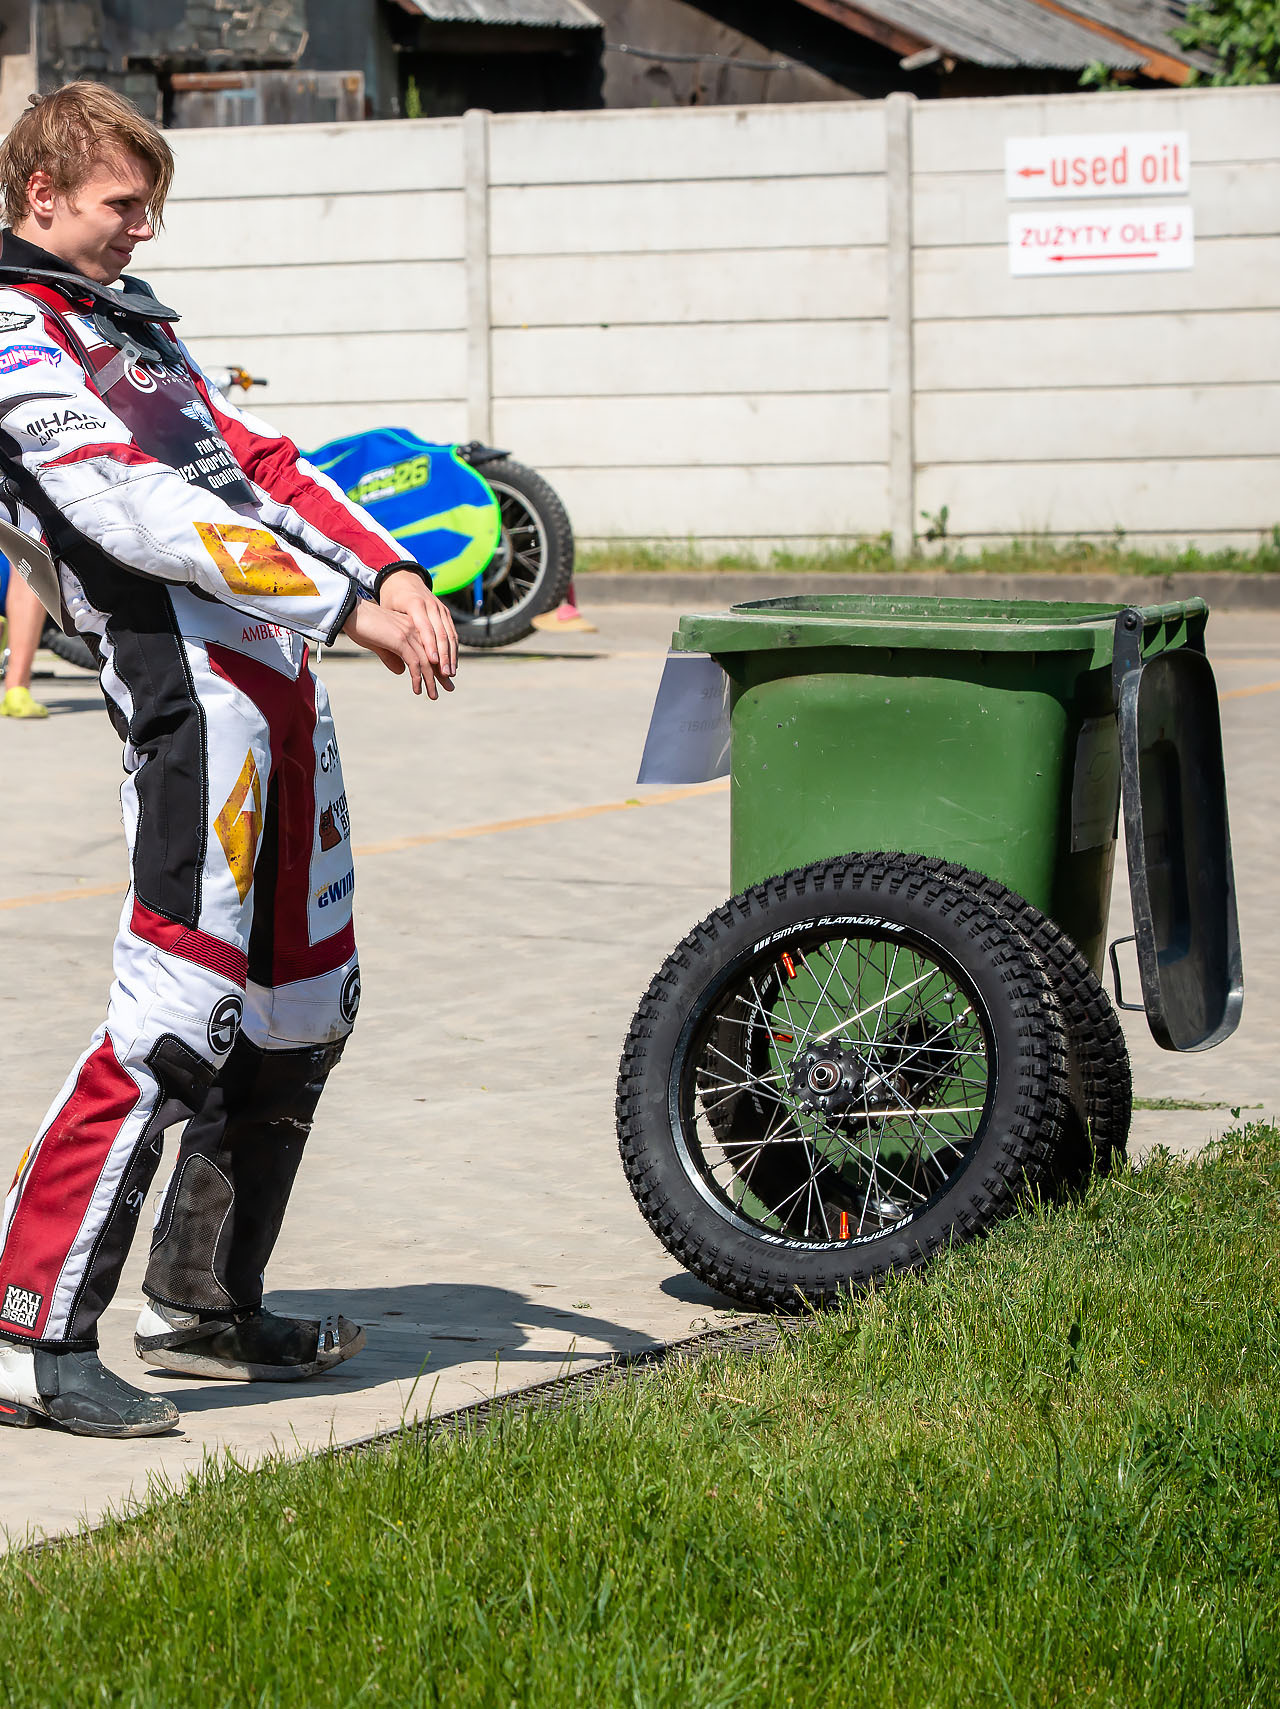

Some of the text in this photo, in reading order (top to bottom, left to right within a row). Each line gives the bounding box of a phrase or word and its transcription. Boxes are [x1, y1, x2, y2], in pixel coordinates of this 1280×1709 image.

[1051, 144, 1182, 187] used oil
[1021, 222, 1183, 247] ZUŻYTY OLEJ
[194, 438, 216, 455] FIM
[241, 623, 282, 643] AMBER
[817, 916, 881, 927] PLATINUM
[785, 1240, 849, 1250] PLATINUM
[6, 1286, 41, 1306] MALI
